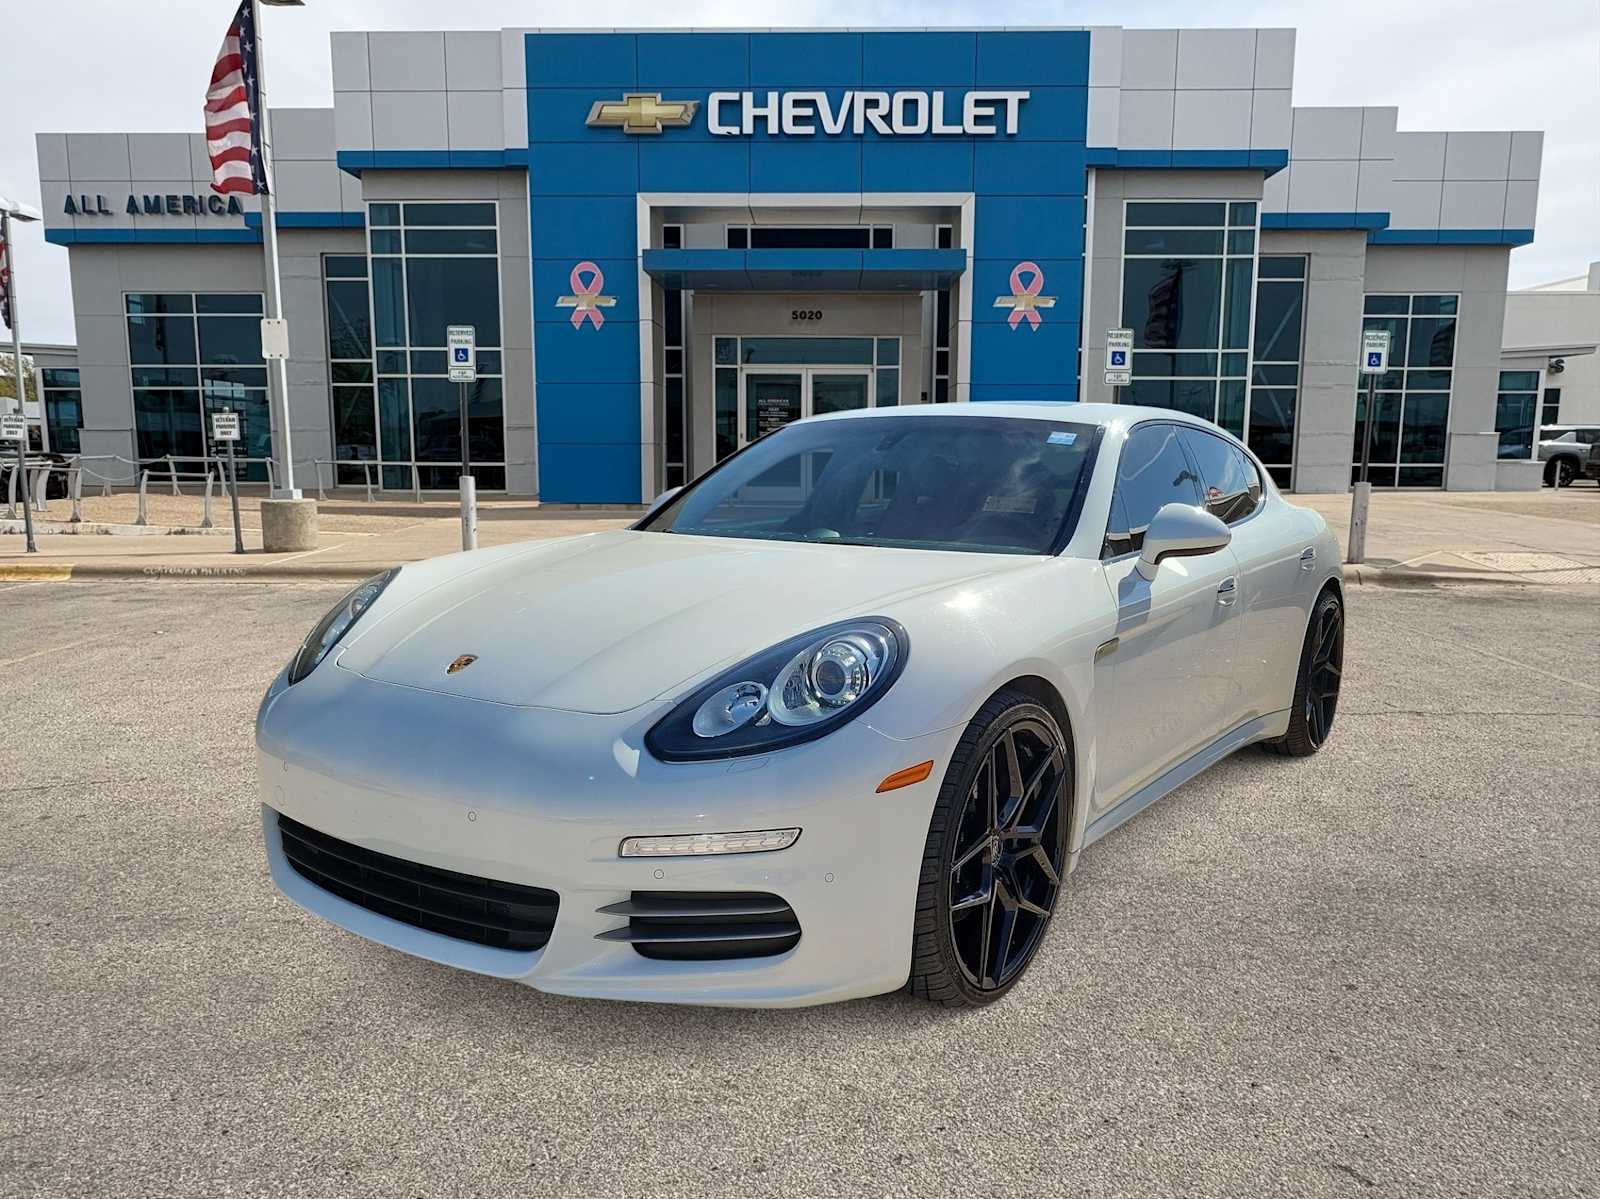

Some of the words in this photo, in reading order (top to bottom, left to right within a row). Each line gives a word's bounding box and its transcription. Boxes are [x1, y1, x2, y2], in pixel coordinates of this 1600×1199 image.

[707, 91, 1031, 135] CHEVROLET
[64, 195, 111, 215] ALL
[126, 195, 242, 215] AMERICA
[791, 310, 823, 320] 5020
